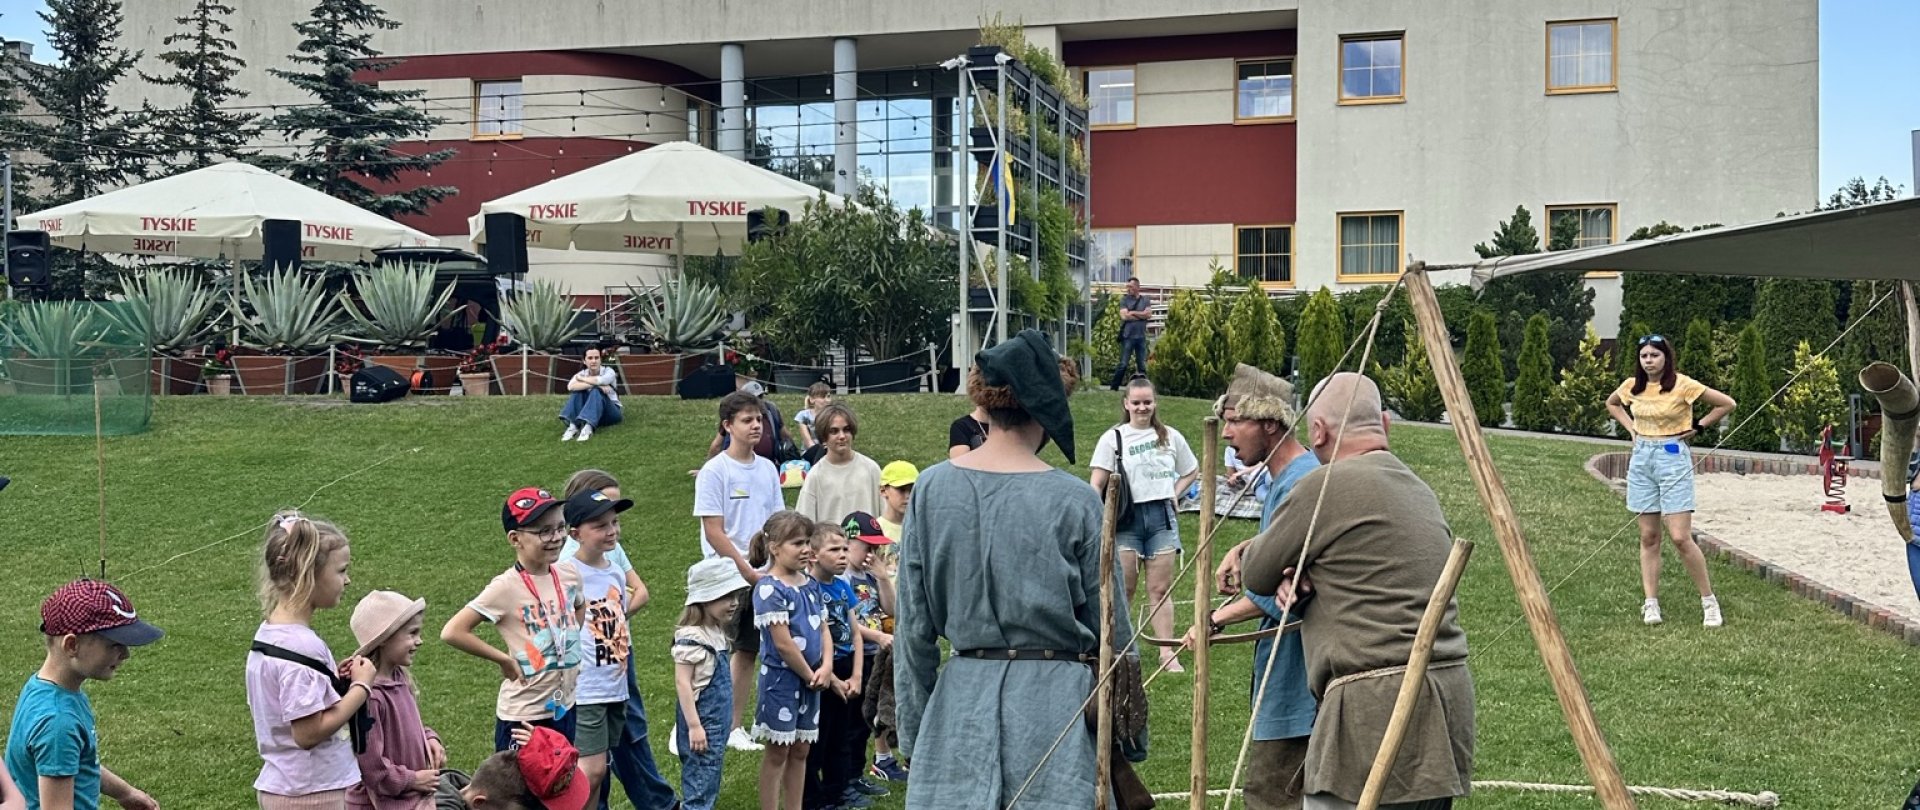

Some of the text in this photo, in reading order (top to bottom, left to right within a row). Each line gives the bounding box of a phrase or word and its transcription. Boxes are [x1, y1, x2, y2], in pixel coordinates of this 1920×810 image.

[528, 203, 578, 219] TYSKIE
[686, 201, 747, 216] TYSKIE
[39, 218, 63, 232] TYSKIE
[140, 217, 197, 231] TYSKIE
[304, 223, 354, 241] TYSKIE
[1128, 440, 1170, 456] GEORG
